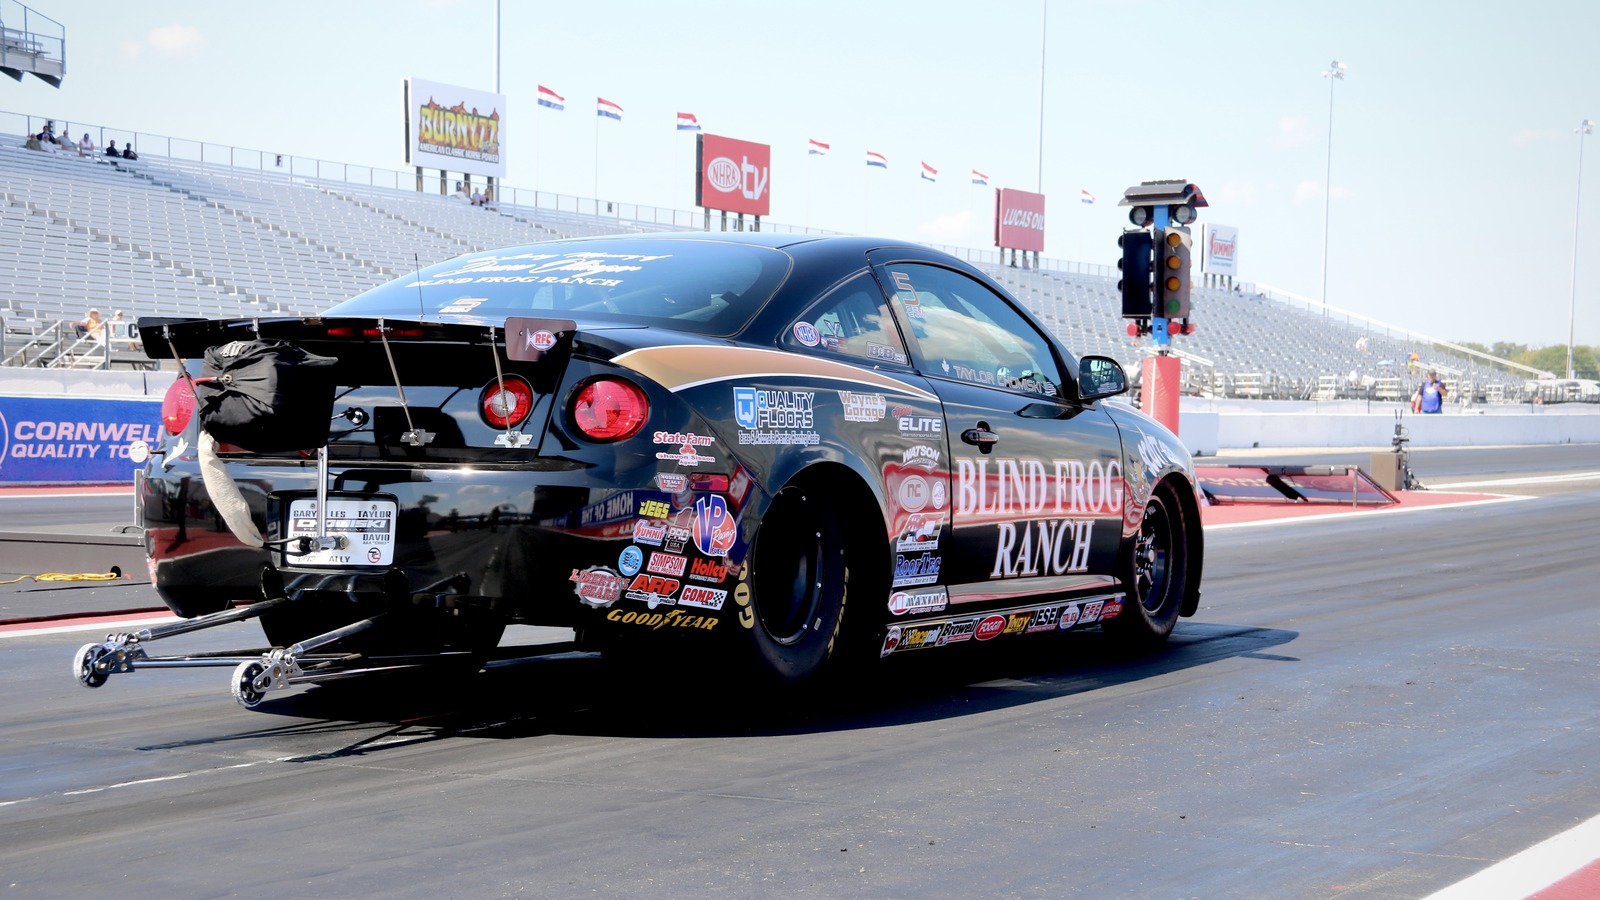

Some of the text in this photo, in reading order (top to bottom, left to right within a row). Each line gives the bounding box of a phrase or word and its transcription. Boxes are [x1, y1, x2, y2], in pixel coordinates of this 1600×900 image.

[1003, 208, 1044, 231] LUCAS OIL
[537, 276, 624, 287] RANCH
[535, 333, 552, 344] RFC
[797, 325, 816, 342] NHRA
[953, 365, 995, 385] TAYLOR
[757, 391, 814, 410] QUALITY
[758, 410, 813, 428] FLOORS
[899, 417, 941, 432] ELITE
[11, 444, 101, 458] QUALITY
[903, 445, 940, 462] WATSON
[955, 457, 1047, 515] BLIND
[1052, 458, 1124, 514] FROG
[293, 510, 317, 518] GARY
[639, 500, 670, 519] JEGS
[636, 521, 664, 539] SUMMIT
[696, 494, 727, 554] VP
[990, 519, 1095, 579] RANCH
[651, 554, 685, 570] SIMPSON
[691, 557, 728, 583] Holley
[569, 569, 630, 590] LIBERTY'S
[629, 574, 680, 596] ARP
[581, 584, 619, 601] GEARS
[682, 587, 715, 602] COMP
[906, 594, 946, 607] MAXIMA
[607, 609, 719, 630] GOODYEAR
[1029, 608, 1060, 627] JESEL
